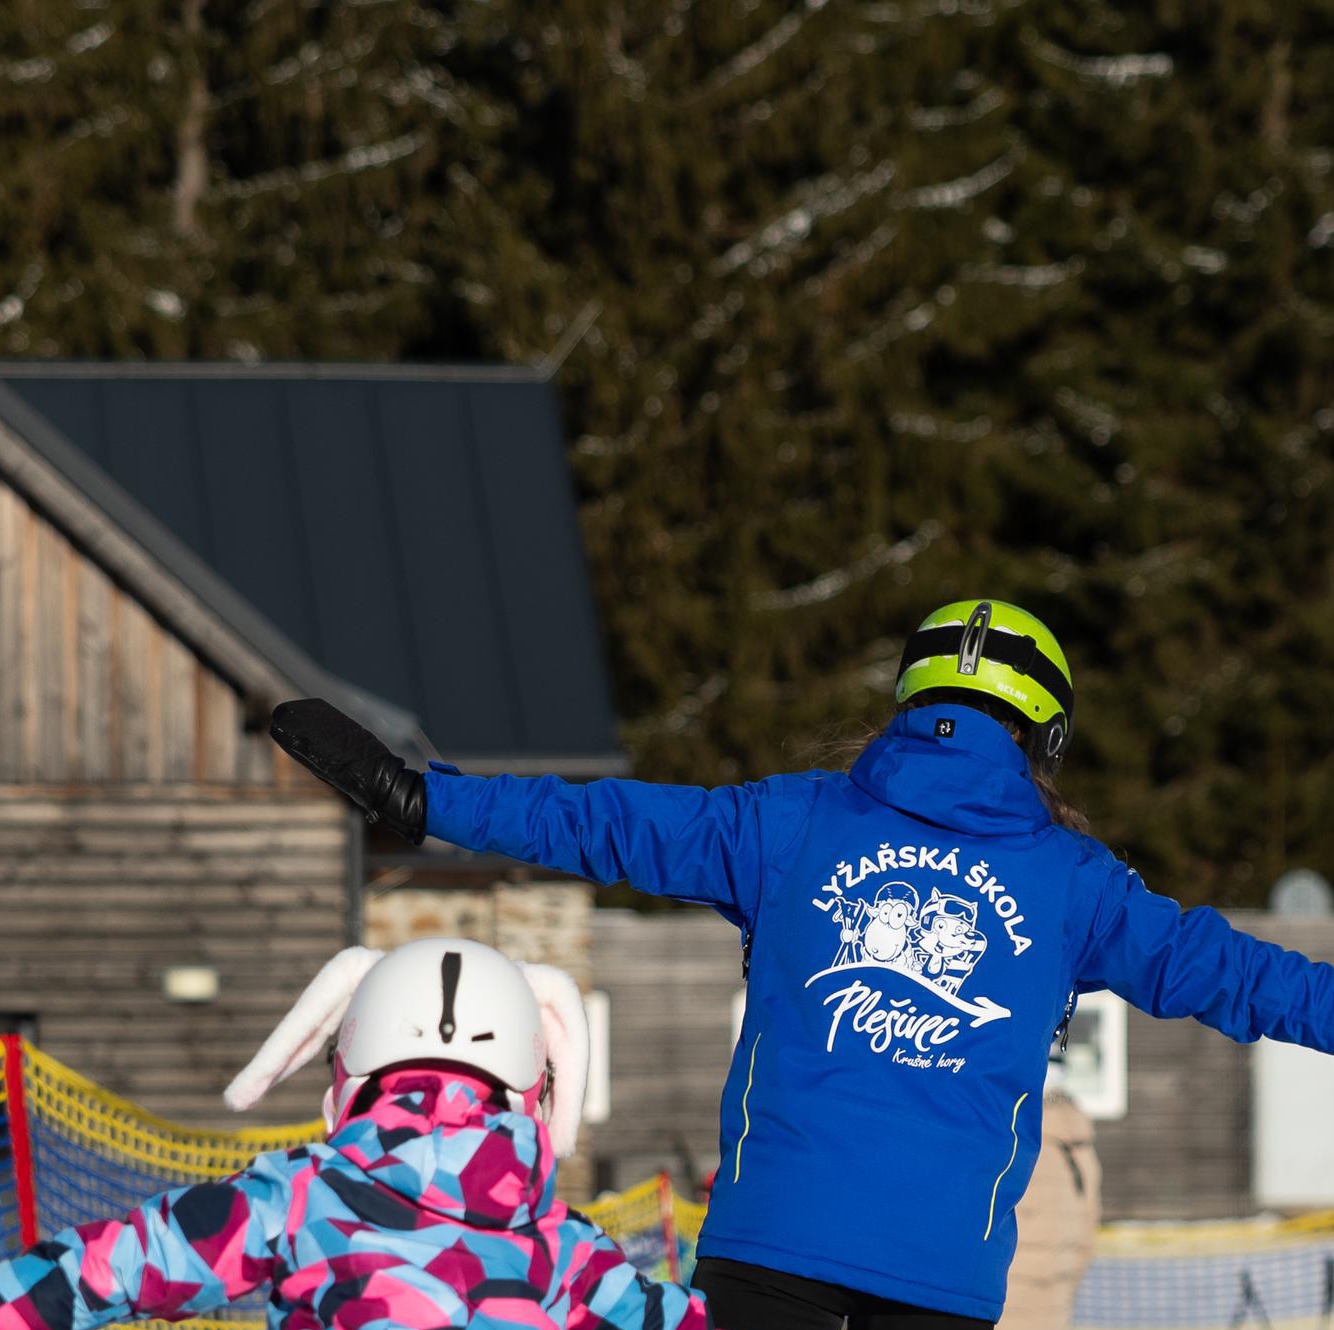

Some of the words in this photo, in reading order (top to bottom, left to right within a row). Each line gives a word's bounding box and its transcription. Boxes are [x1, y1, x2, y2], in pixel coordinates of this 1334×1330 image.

[812, 842, 960, 912] LYŽAŘSKÁ
[964, 860, 1033, 956] ŠKOLA
[823, 980, 960, 1053] Plešivec
[892, 1048, 934, 1069] Krušné
[936, 1052, 966, 1073] hory
